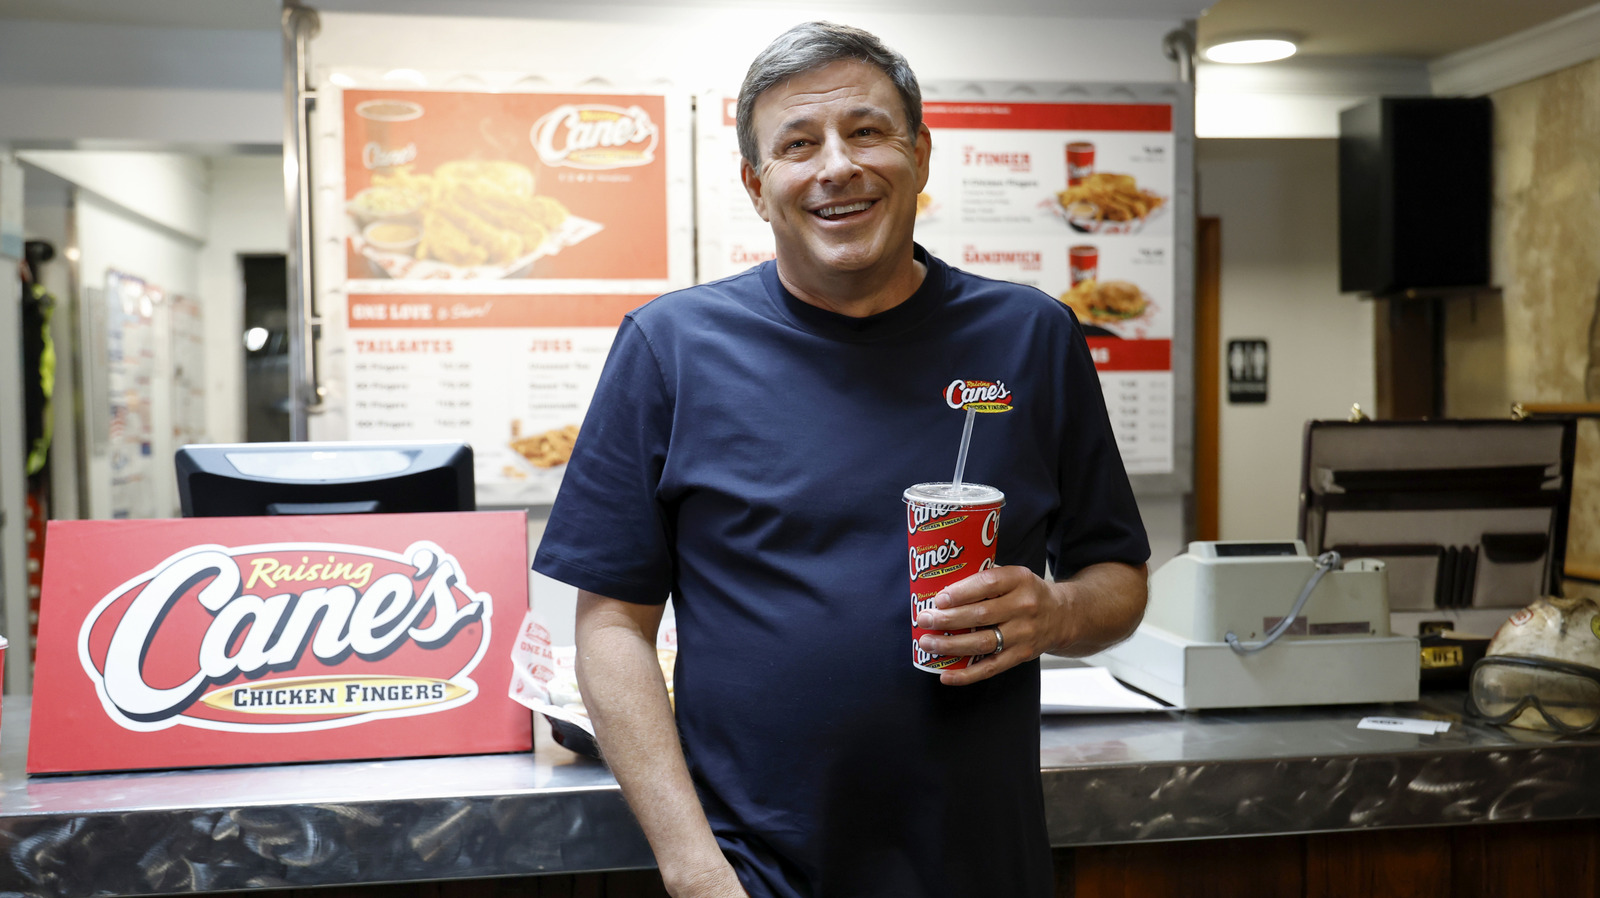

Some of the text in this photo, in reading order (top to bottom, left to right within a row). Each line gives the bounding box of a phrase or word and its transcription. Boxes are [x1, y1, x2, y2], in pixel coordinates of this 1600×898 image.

[352, 303, 387, 320] ONE
[389, 303, 433, 320] LOVE
[356, 339, 453, 354] TAILGATES
[946, 379, 1011, 410] Cane's
[245, 556, 374, 589] Raising
[909, 538, 964, 581] Cane's
[917, 590, 938, 600] Raisin
[104, 548, 484, 722] Cane's
[233, 684, 444, 707] CHICKEN FINGERS
